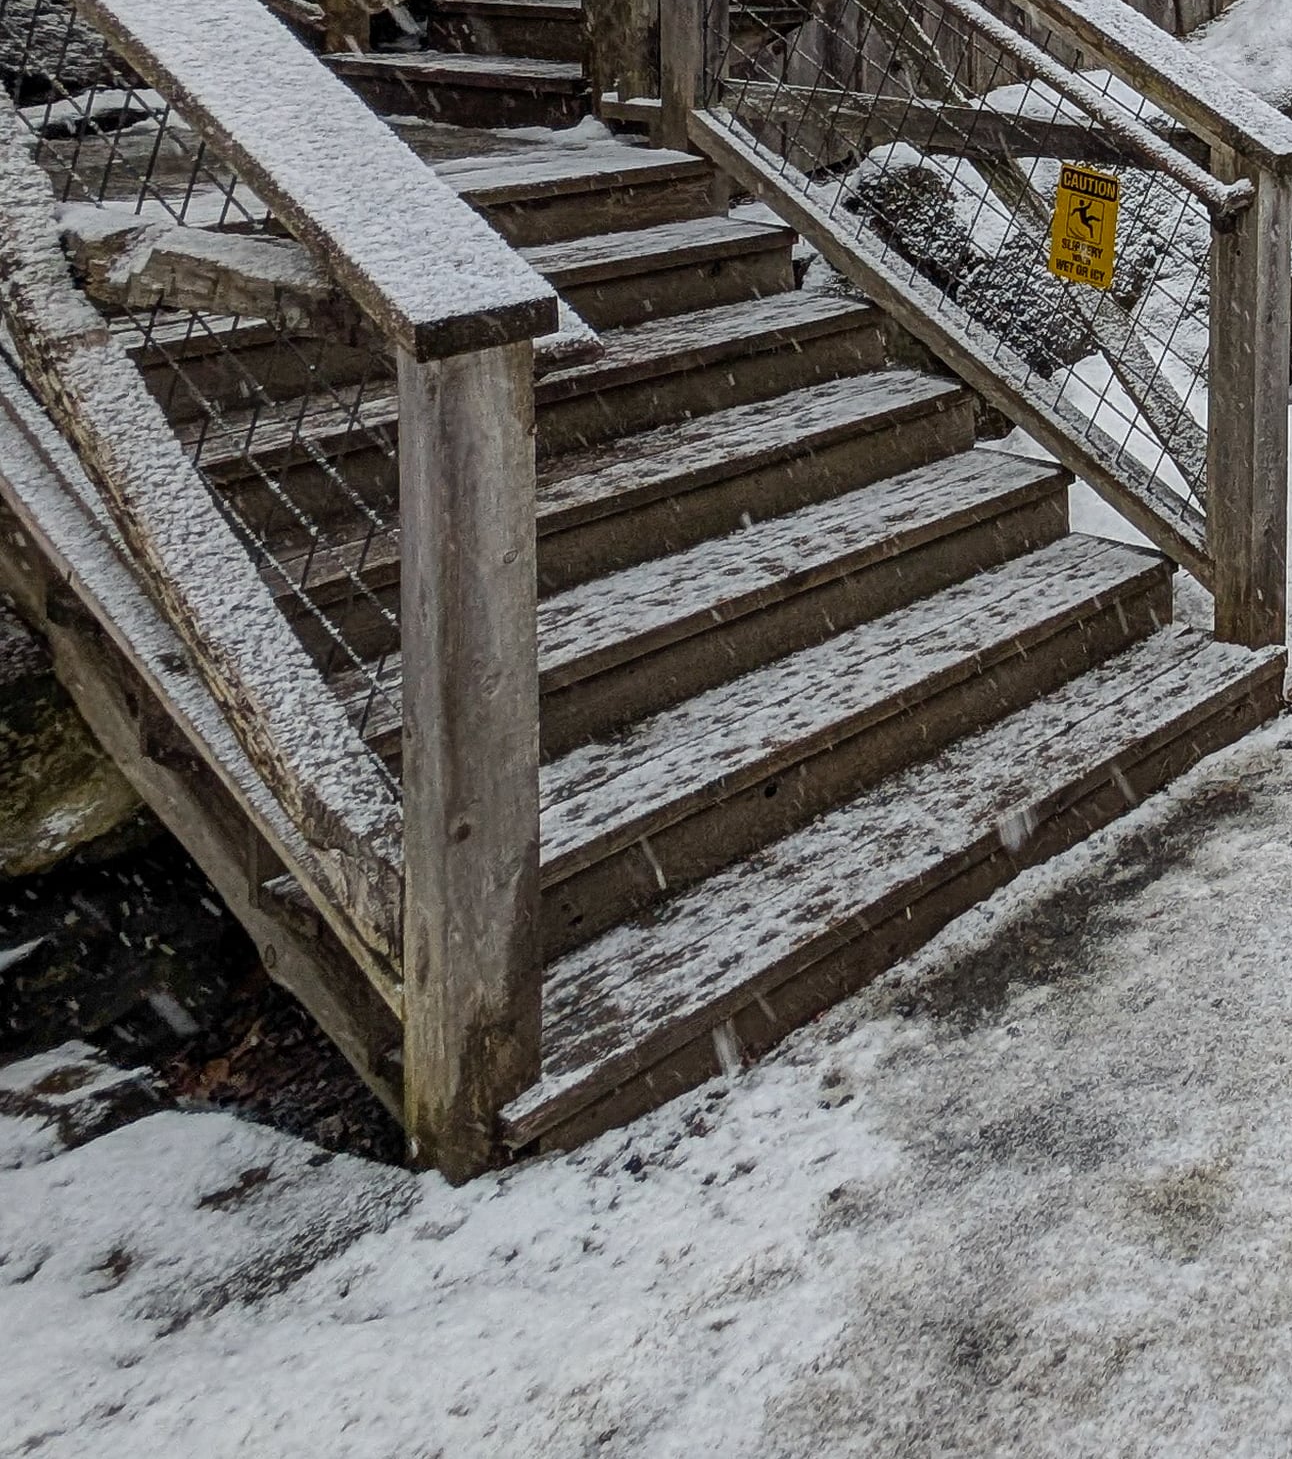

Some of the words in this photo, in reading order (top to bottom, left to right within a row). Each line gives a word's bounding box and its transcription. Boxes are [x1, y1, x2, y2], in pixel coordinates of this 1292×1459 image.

[1063, 171, 1116, 199] CAUTION
[1056, 258, 1074, 273] WET
[1076, 264, 1088, 278] OR
[1090, 268, 1105, 282] ICY
